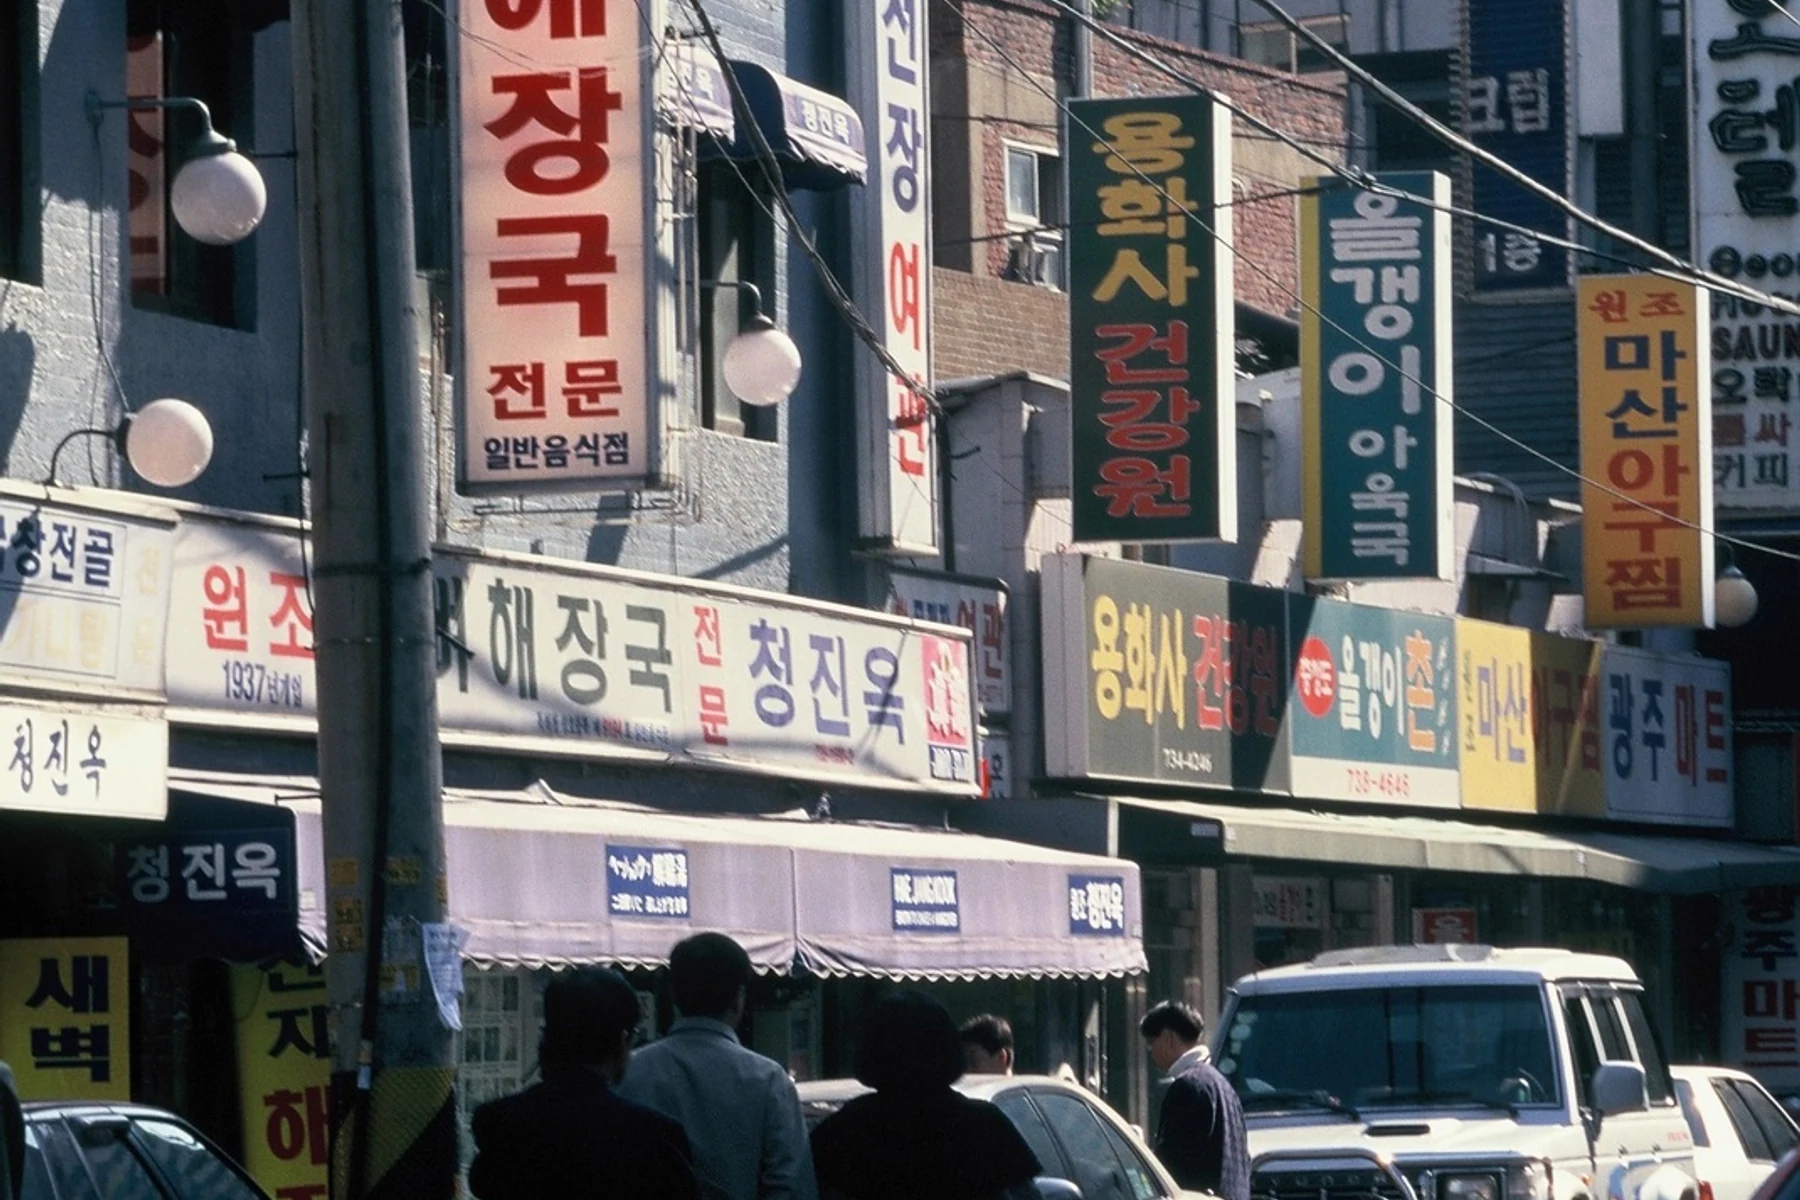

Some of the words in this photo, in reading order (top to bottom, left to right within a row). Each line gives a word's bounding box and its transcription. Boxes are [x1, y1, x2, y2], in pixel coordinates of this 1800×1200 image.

[1588, 289, 1686, 323] 원조
[486, 359, 623, 420] 전문
[484, 430, 630, 471] 일반음식점
[203, 563, 317, 661] 원조
[748, 617, 906, 745] 청진옥
[8, 718, 107, 798] 청진옥
[127, 841, 282, 903] 청진옥
[25, 955, 111, 1083] 새벽
